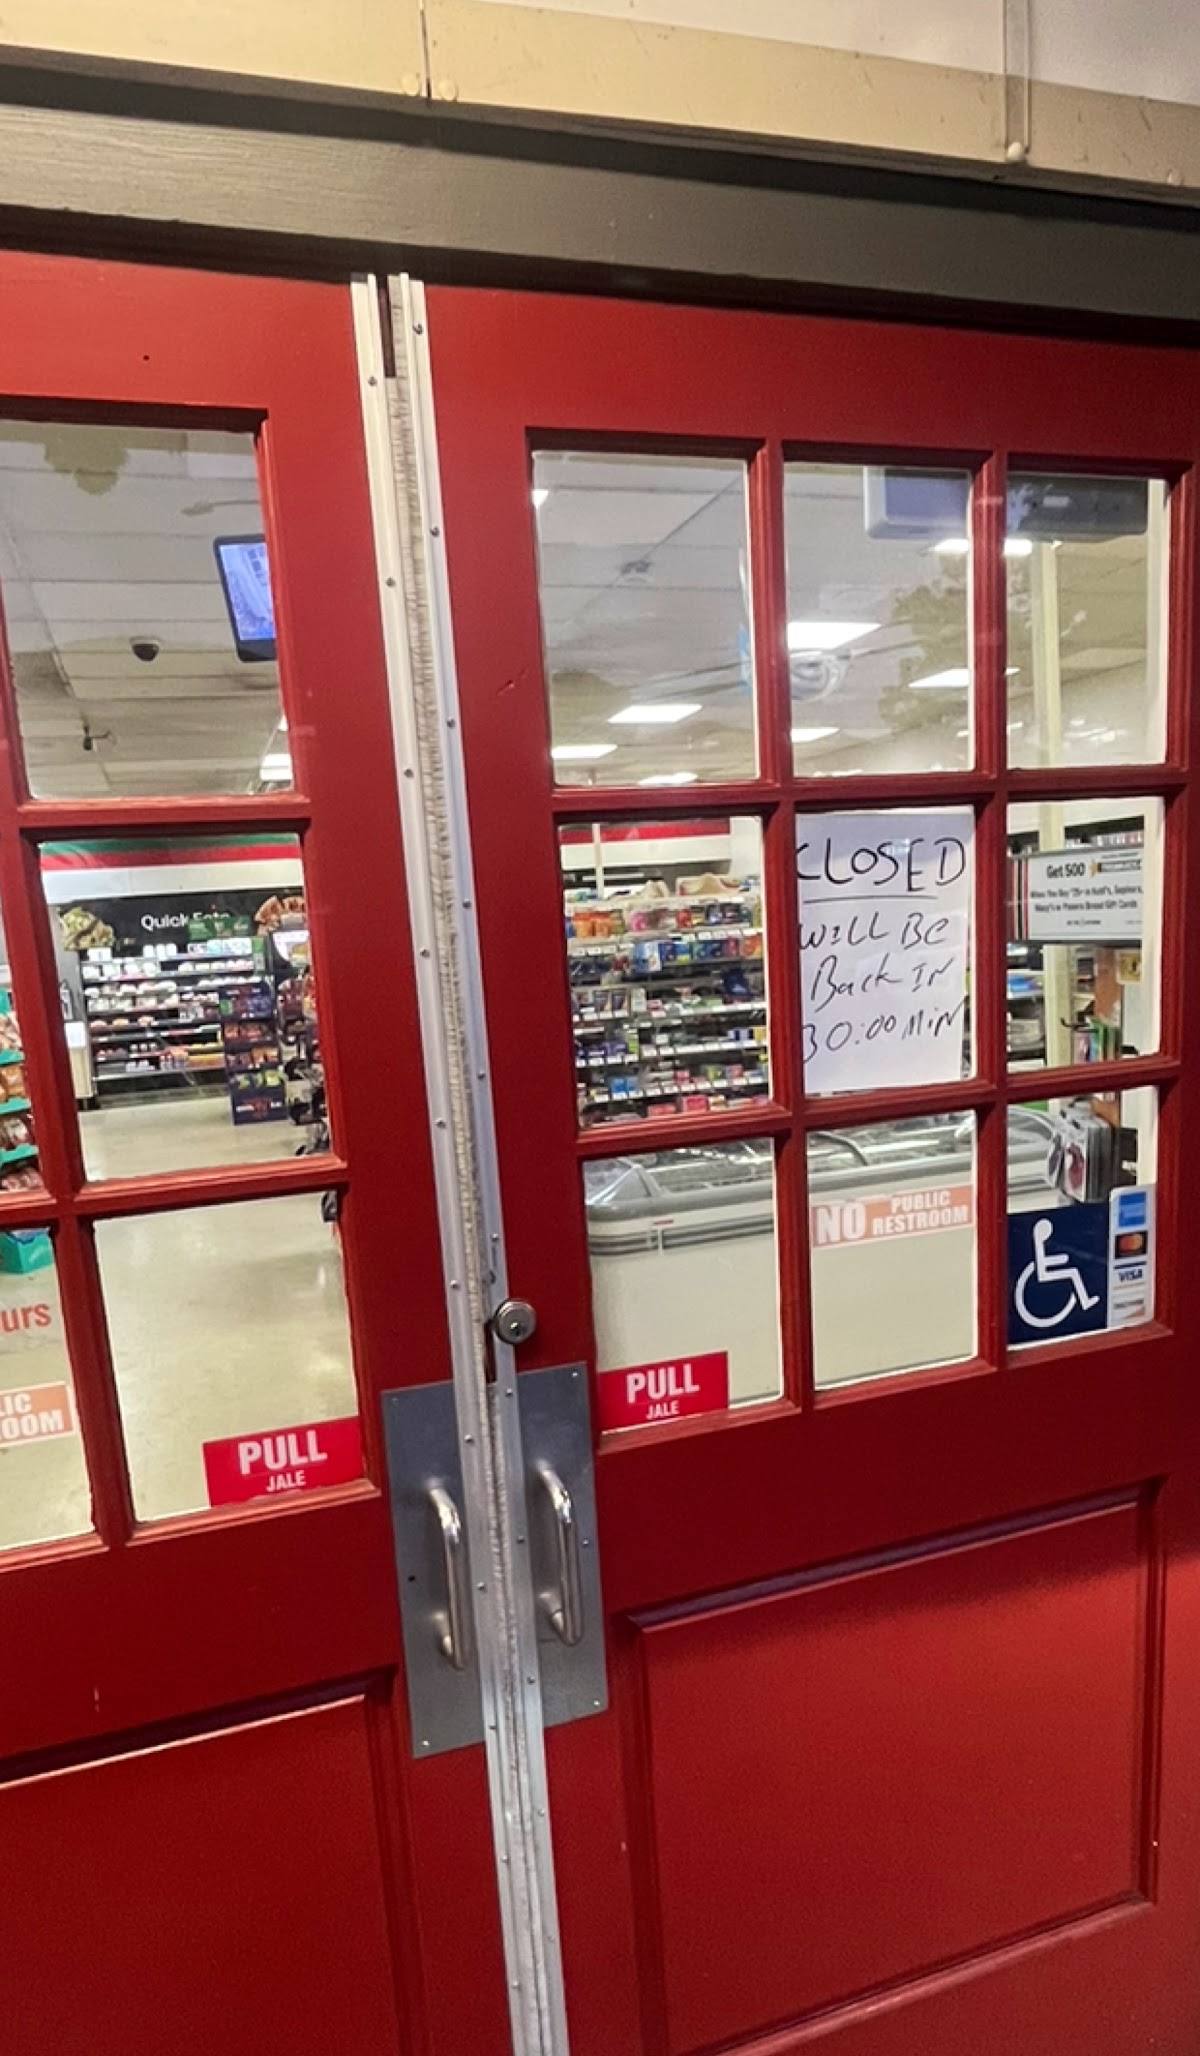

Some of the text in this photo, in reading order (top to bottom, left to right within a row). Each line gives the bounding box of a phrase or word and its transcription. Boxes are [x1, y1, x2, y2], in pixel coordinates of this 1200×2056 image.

[795, 837, 966, 893] CLOSED
[1046, 864, 1063, 878] Get
[1065, 862, 1085, 878] 500
[141, 912, 189, 932] Quick
[798, 911, 889, 951] WILL
[810, 952, 903, 1014] Back
[891, 1190, 952, 1214] PUBLIC
[816, 1202, 867, 1245] NO
[872, 1204, 969, 1236] RESTROOM
[626, 1363, 700, 1404] PULL
[0, 1409, 64, 1440] OOM
[646, 1400, 679, 1420] JALE
[238, 1430, 328, 1475] PULL
[266, 1469, 306, 1492] JALE
